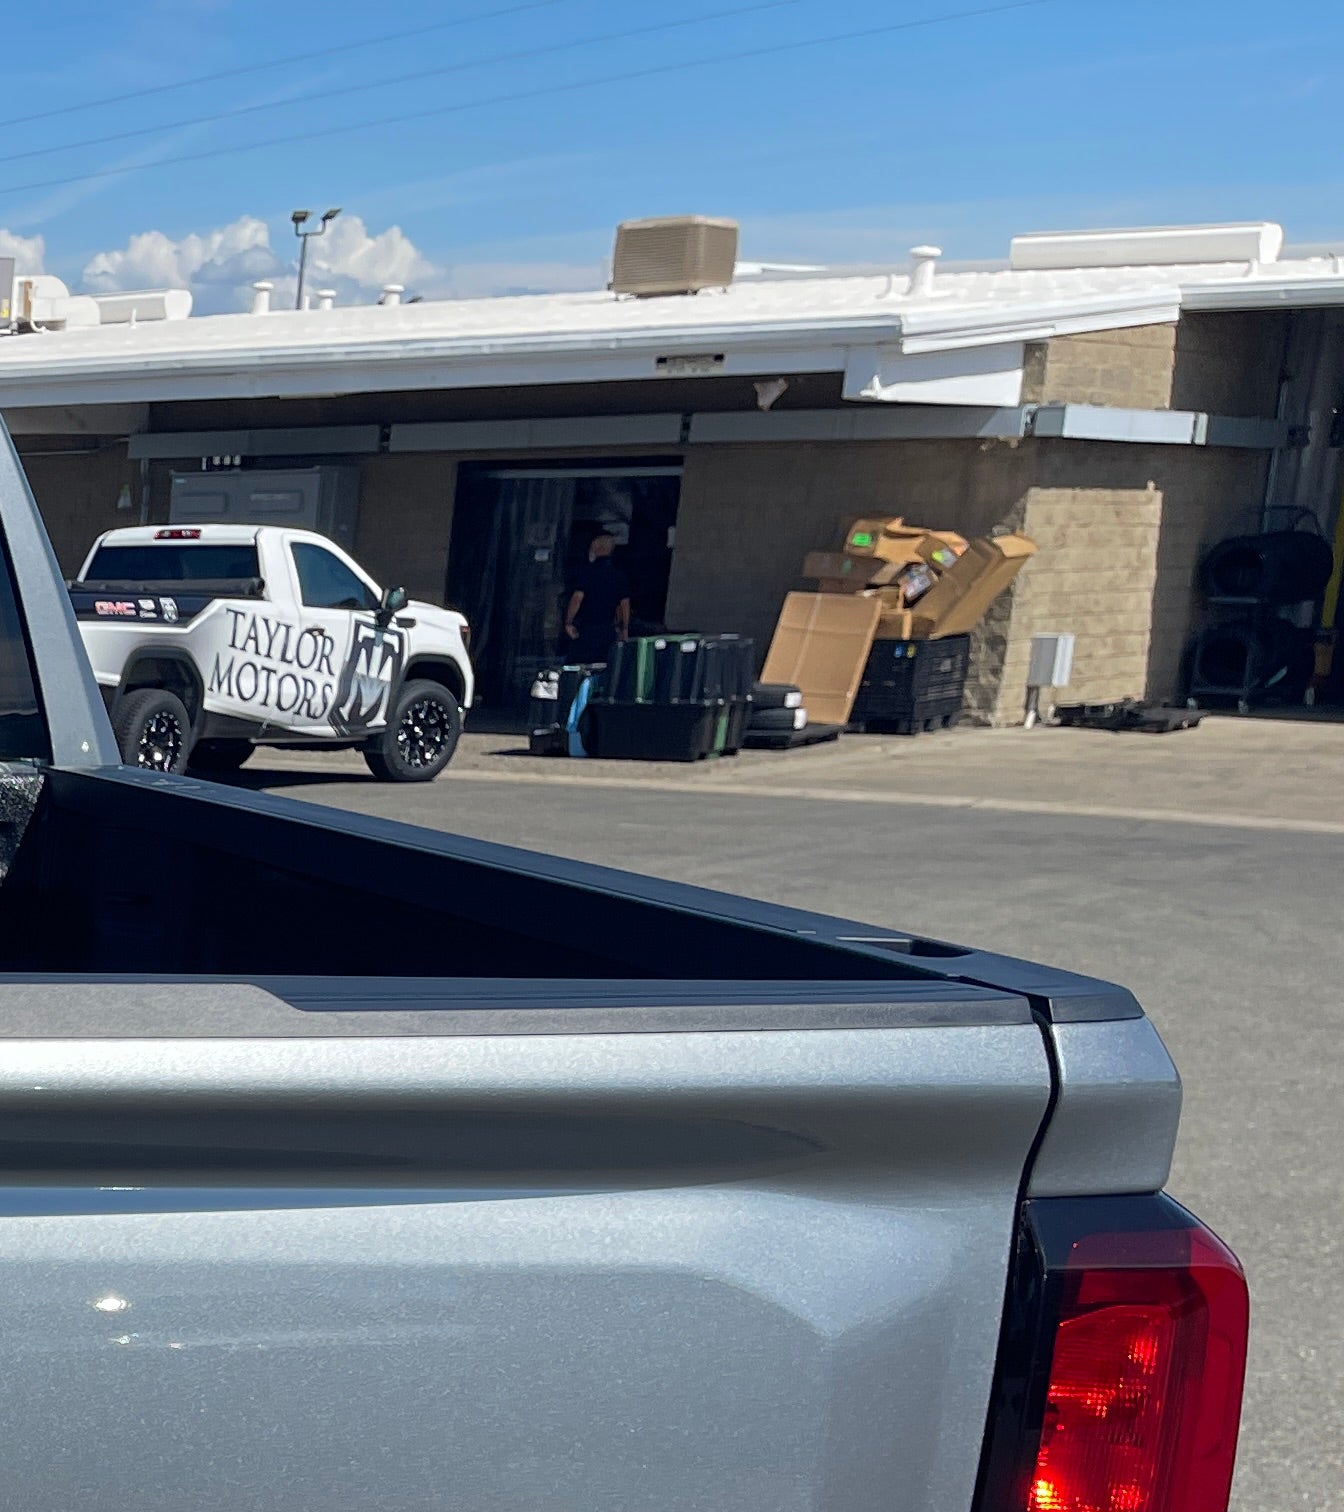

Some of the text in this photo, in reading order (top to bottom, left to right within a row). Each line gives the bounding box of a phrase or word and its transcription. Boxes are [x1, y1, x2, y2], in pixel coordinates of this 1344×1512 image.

[95, 601, 136, 615] GMC
[226, 608, 335, 676] TAYLOR
[208, 652, 333, 720] MOTORS
